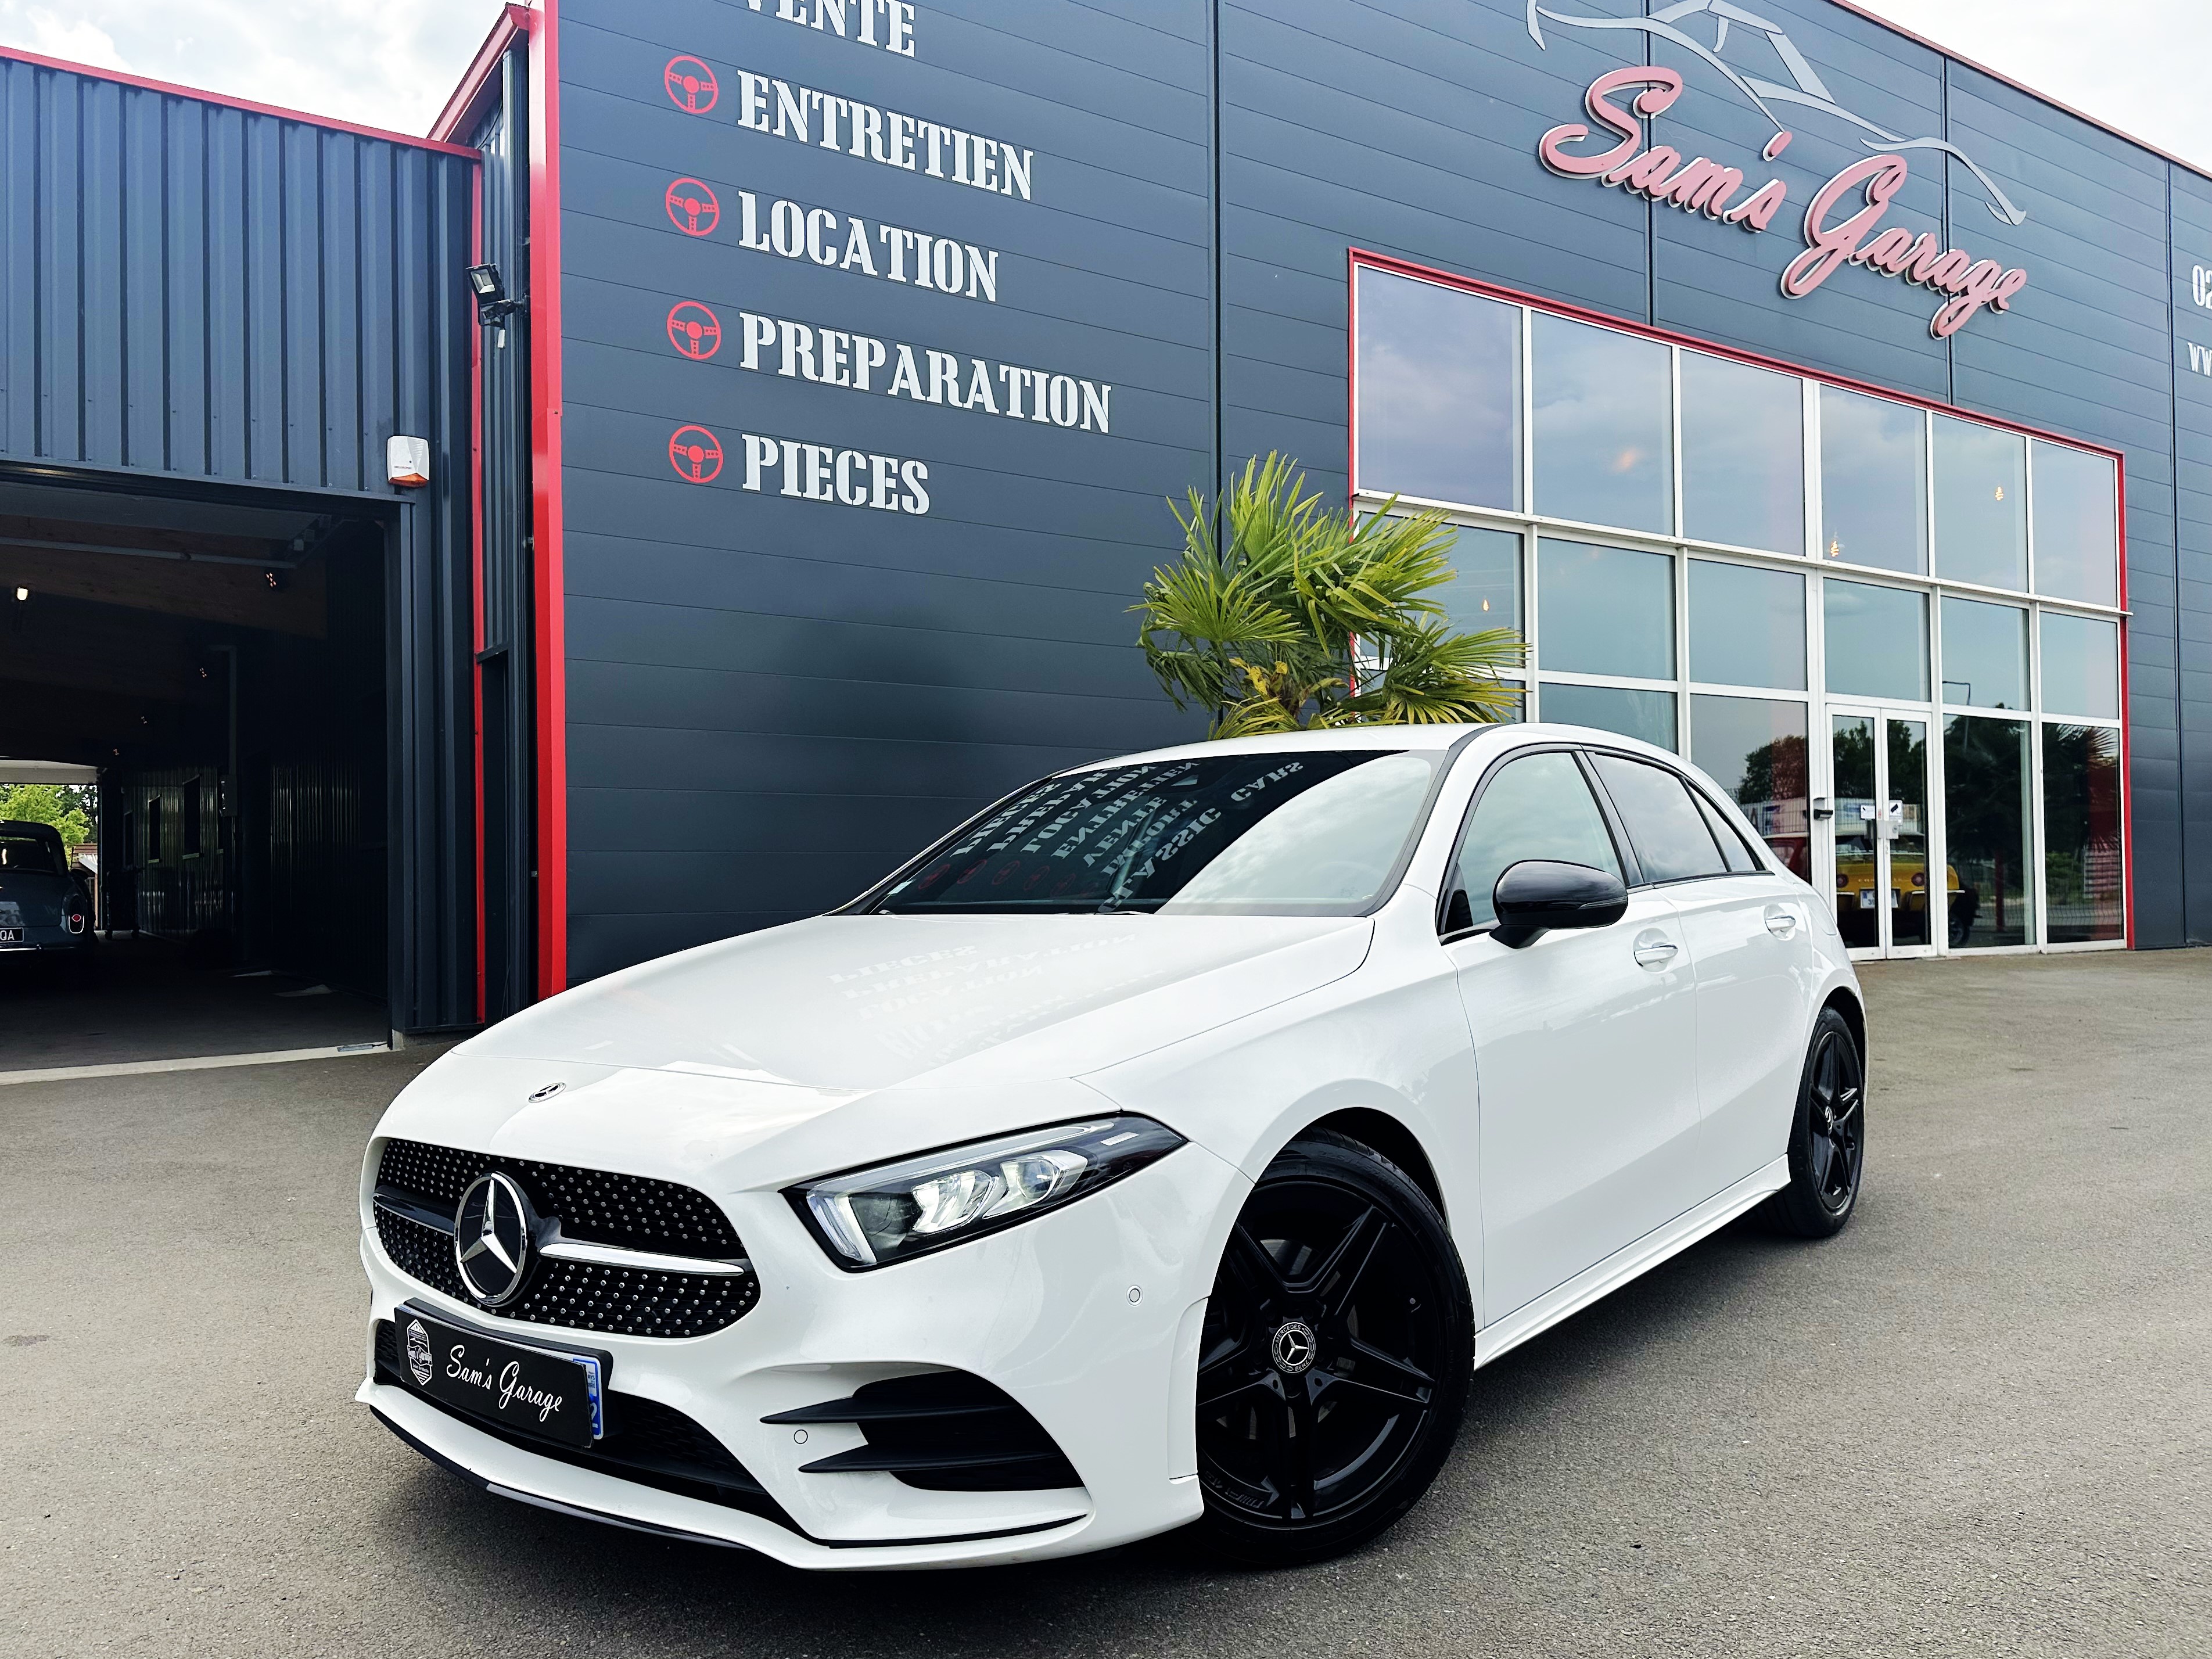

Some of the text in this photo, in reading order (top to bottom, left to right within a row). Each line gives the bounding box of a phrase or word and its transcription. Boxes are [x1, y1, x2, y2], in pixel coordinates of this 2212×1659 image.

[737, 69, 1034, 200] ENTRETIEN
[738, 190, 999, 302] LOCATION
[1539, 66, 2027, 340] Sam's Garage
[739, 311, 1112, 433] PREPARATION
[741, 433, 929, 516] PIECES
[1275, 1324, 1301, 1343] MERCEDES
[1295, 1359, 1309, 1371] BENZ
[446, 1345, 562, 1422] Sam's Garage
